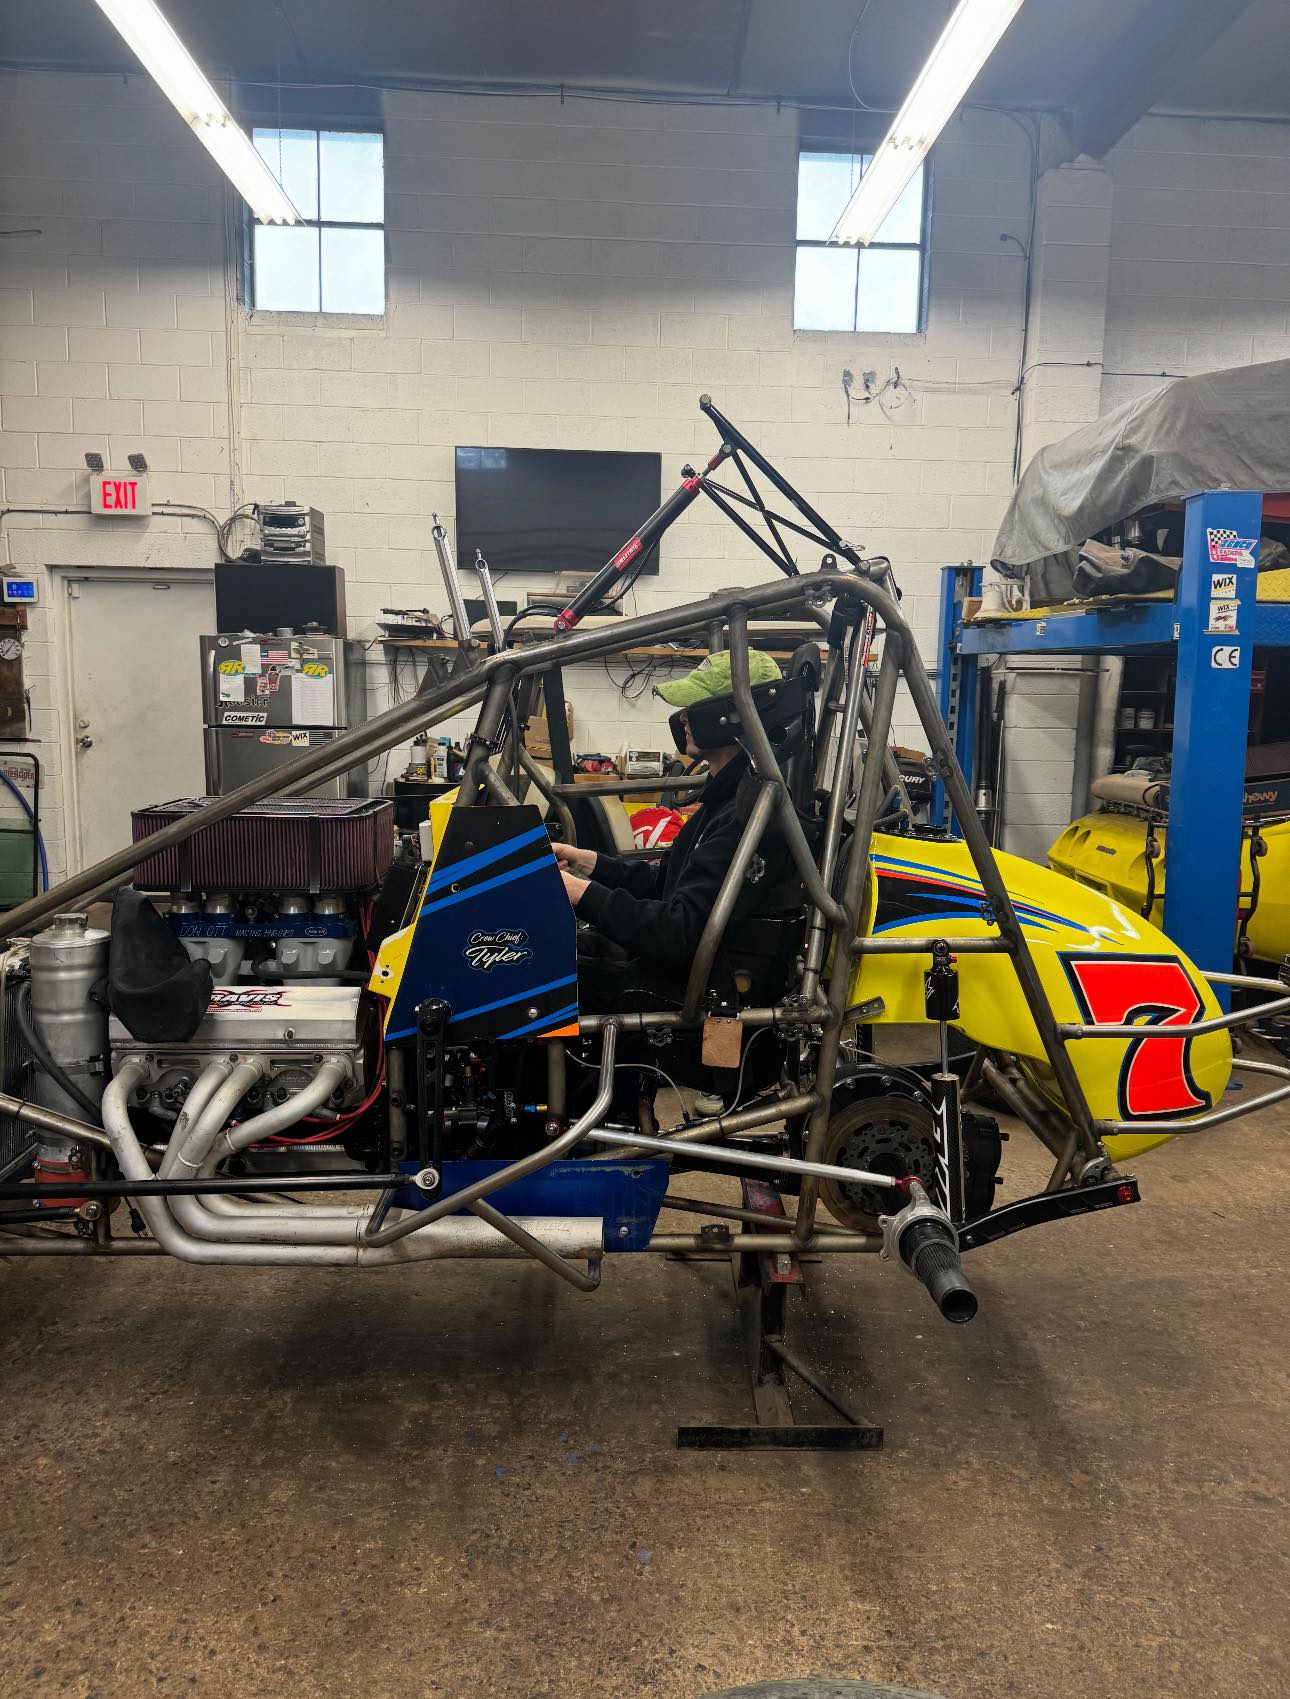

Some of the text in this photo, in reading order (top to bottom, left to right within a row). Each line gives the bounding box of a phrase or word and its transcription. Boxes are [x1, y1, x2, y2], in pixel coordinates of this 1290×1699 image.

[102, 481, 138, 509] EXIT
[1213, 576, 1235, 590] WIX
[1217, 604, 1230, 612] WIX
[1213, 648, 1239, 667] CE
[293, 731, 309, 741] WIX
[179, 925, 202, 937] DON
[206, 925, 228, 937] OTT
[235, 929, 262, 937] RACING
[263, 929, 295, 937] ENGINES
[471, 931, 524, 945] Crew Chief:
[466, 945, 528, 969] Tyler
[1055, 951, 1213, 1122] 7
